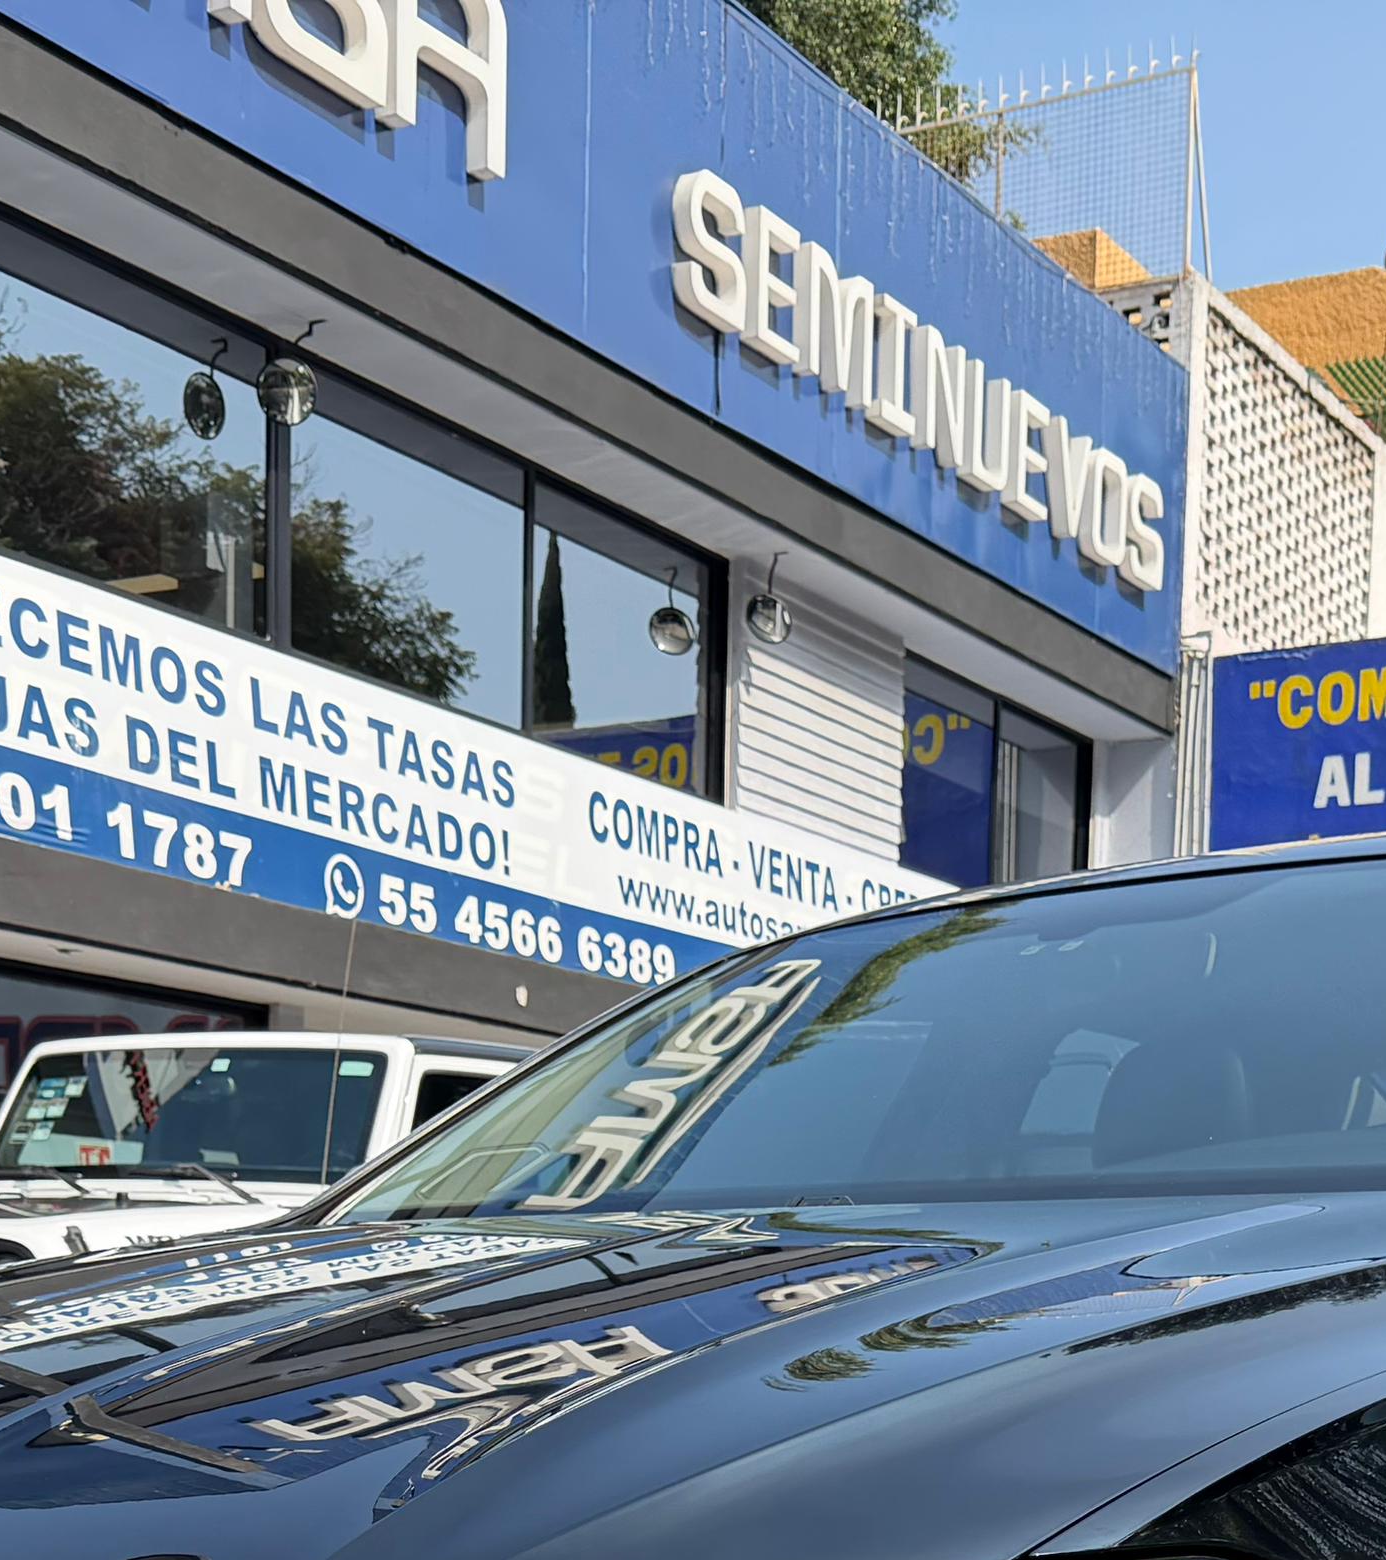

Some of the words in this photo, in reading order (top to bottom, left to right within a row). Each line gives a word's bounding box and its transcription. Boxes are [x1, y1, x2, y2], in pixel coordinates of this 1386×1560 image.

[671, 168, 1164, 593] SEMINUEVOS
[127, 717, 238, 799] DEL
[260, 756, 510, 875] MERCADO!
[250, 677, 349, 756] LAS
[367, 709, 515, 808] TASAS
[1314, 751, 1385, 809] AL
[105, 802, 252, 888] 1787
[589, 791, 723, 878] COMPRA
[748, 841, 839, 913] VENTA
[378, 873, 437, 934] 55
[454, 894, 562, 964] 4566
[577, 926, 676, 987] 6389
